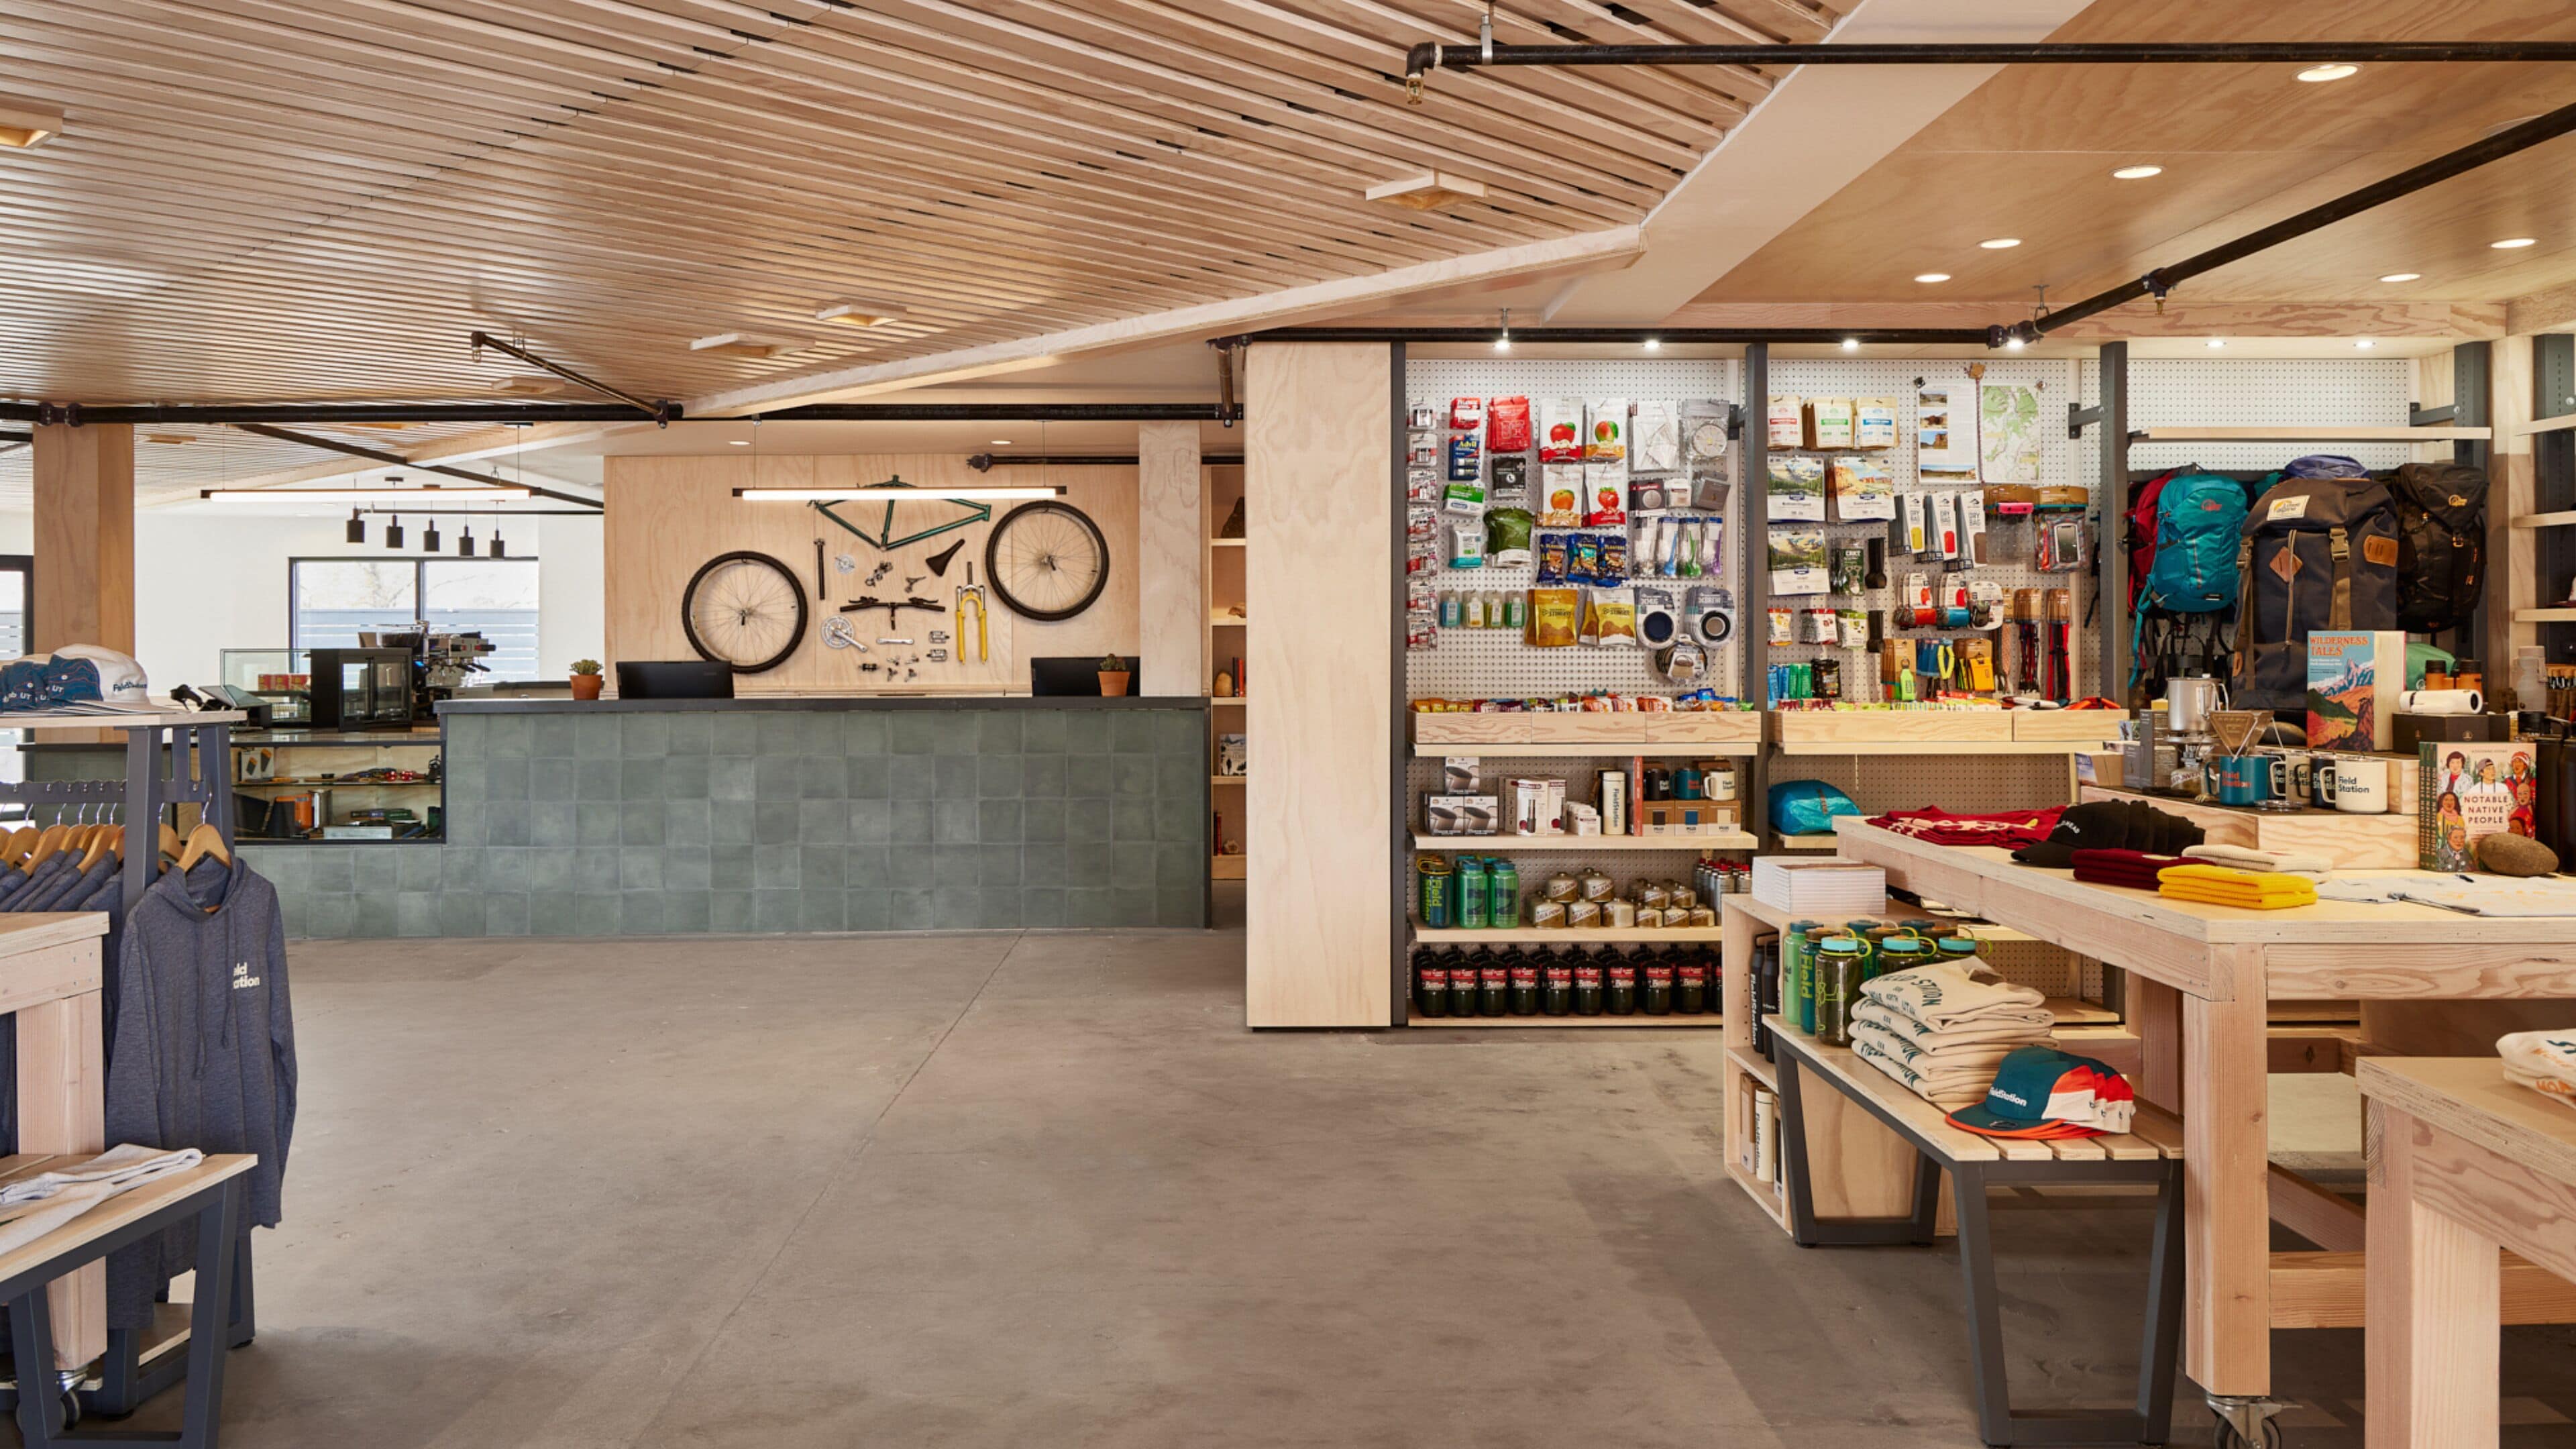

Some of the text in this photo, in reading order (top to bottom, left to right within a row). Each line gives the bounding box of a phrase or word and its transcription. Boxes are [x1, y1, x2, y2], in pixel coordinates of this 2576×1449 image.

[2309, 635, 2369, 647] WILDERNESS
[2310, 646, 2343, 656] TALES
[52, 685, 64, 693] UT
[2222, 771, 2240, 780] Field
[2338, 776, 2357, 785] Field
[2222, 780, 2252, 788] Station
[2338, 785, 2370, 794] Station
[1612, 788, 1620, 828] FieldStation
[1432, 879, 1442, 906] Field
[233, 962, 248, 976] eld
[233, 975, 260, 989] ation
[1801, 955, 1813, 999] Field
